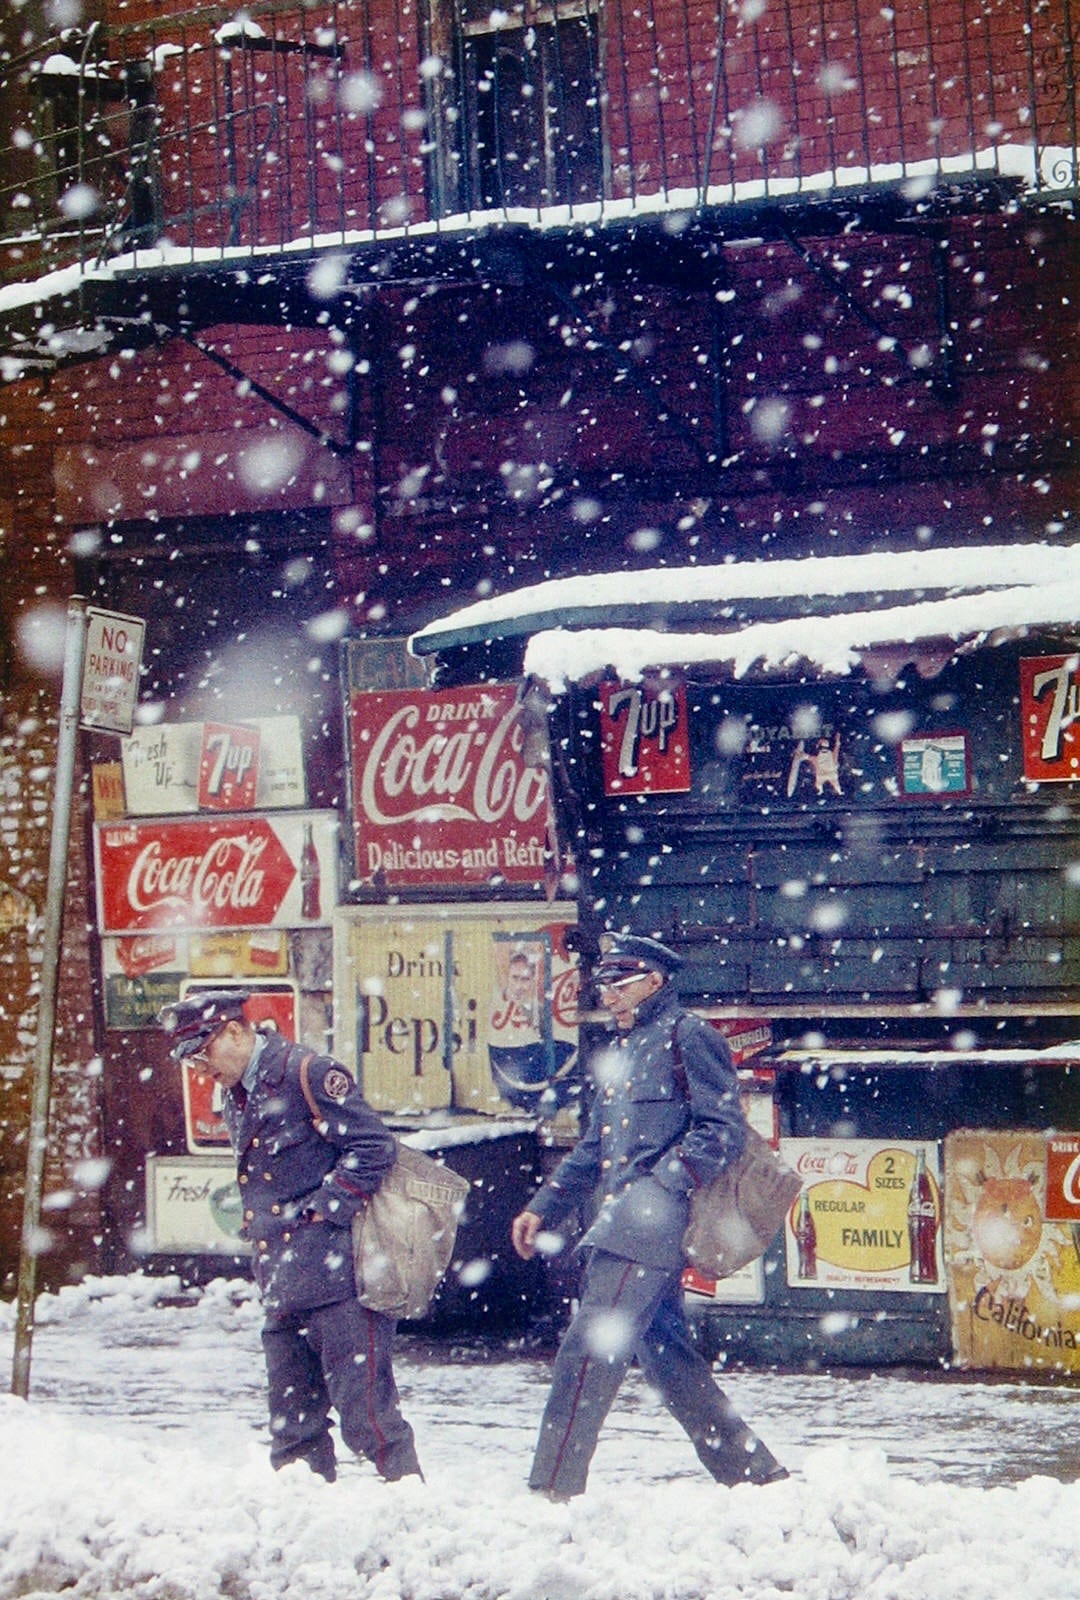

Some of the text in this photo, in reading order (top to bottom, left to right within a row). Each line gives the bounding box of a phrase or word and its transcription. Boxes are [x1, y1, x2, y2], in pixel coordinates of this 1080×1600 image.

[101, 626, 128, 653] NO
[89, 654, 134, 683] PARKING
[426, 702, 501, 722] DRINK
[367, 840, 461, 870] Delicious
[461, 839, 500, 867] and
[127, 834, 269, 912] Coca-Cola
[884, 1156, 897, 1175] 2
[874, 1176, 906, 1190] SIZES
[814, 1200, 866, 1214] REGULAR
[841, 1228, 904, 1251] FAMILY
